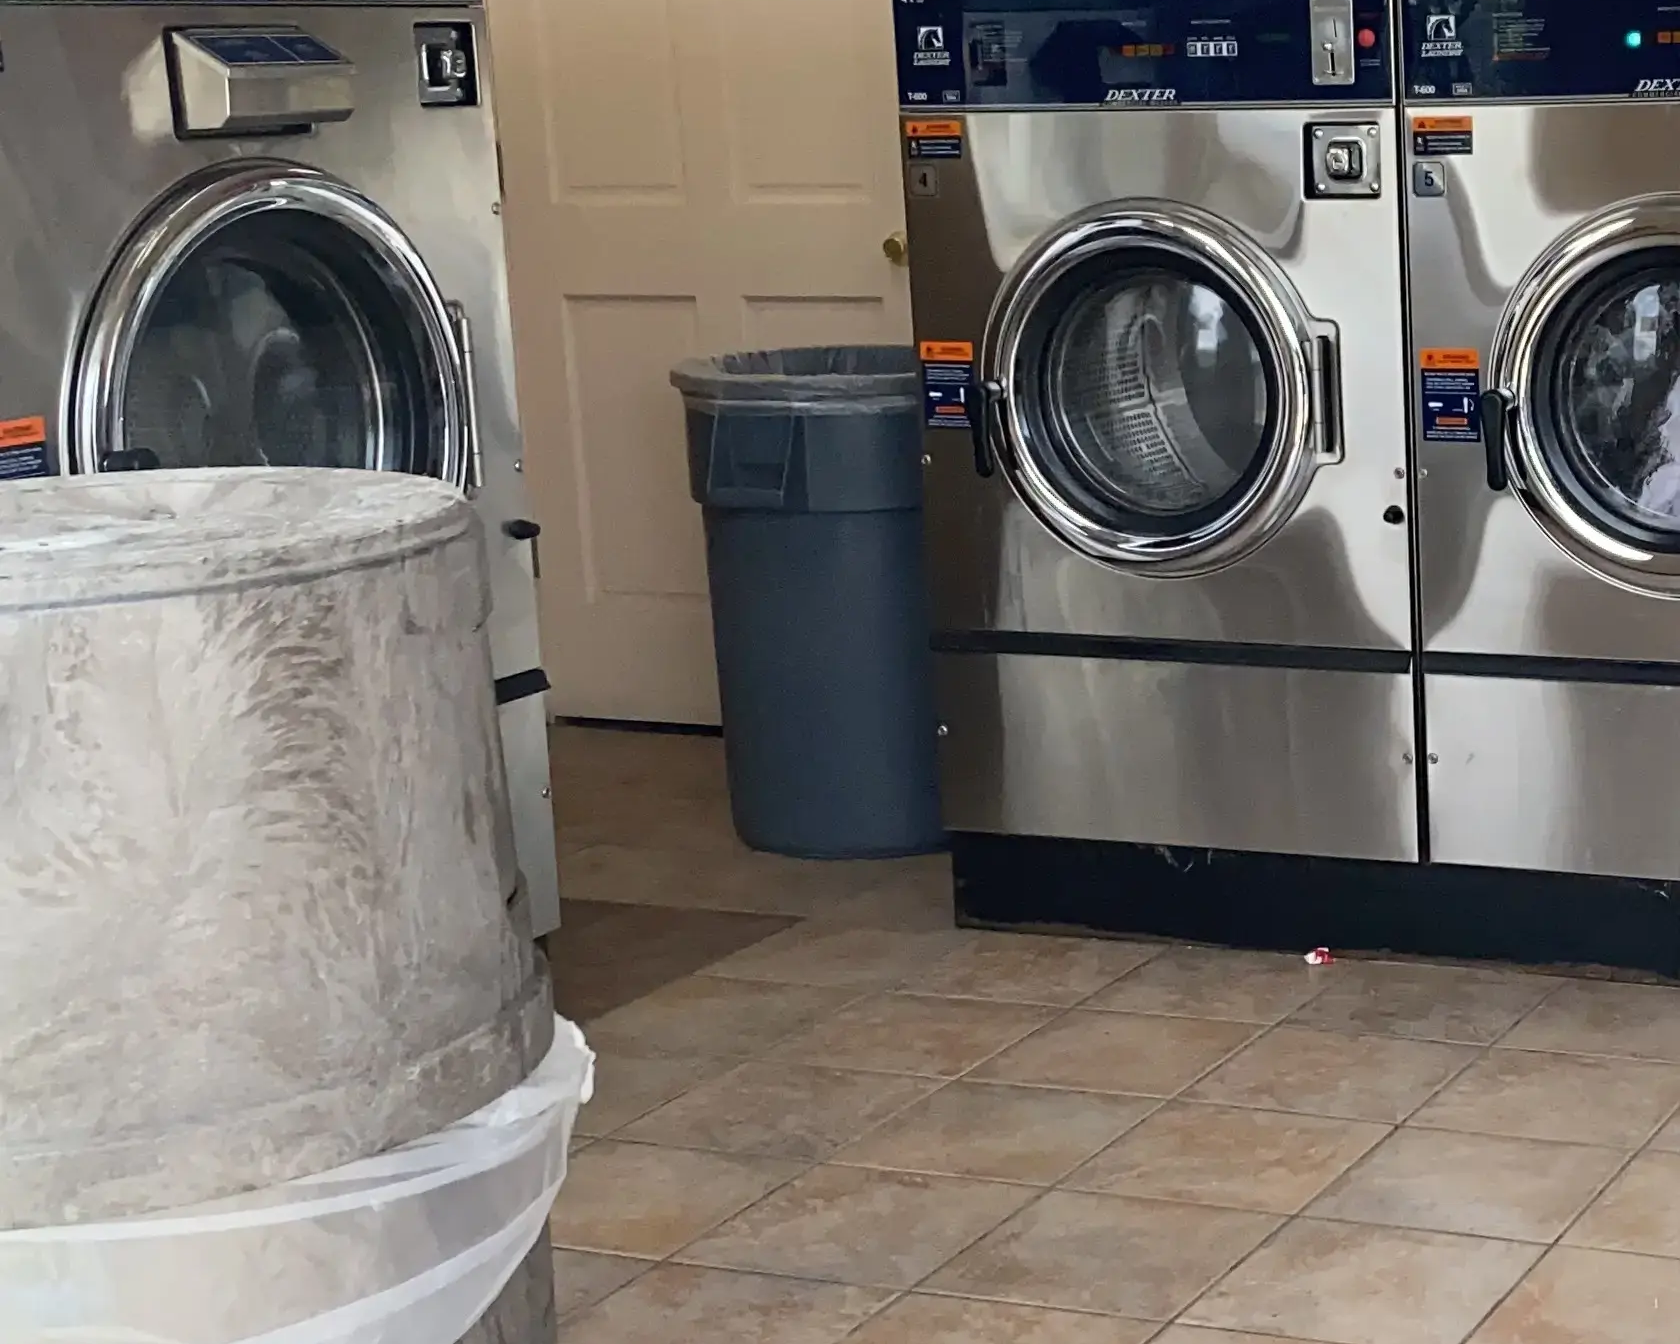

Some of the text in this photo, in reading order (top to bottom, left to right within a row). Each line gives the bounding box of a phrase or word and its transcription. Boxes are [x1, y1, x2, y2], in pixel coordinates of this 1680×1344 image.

[1421, 41, 1462, 50] DEXTER
[1104, 88, 1176, 101] DEXTER
[919, 172, 928, 188] 4
[1424, 170, 1435, 187] 5
